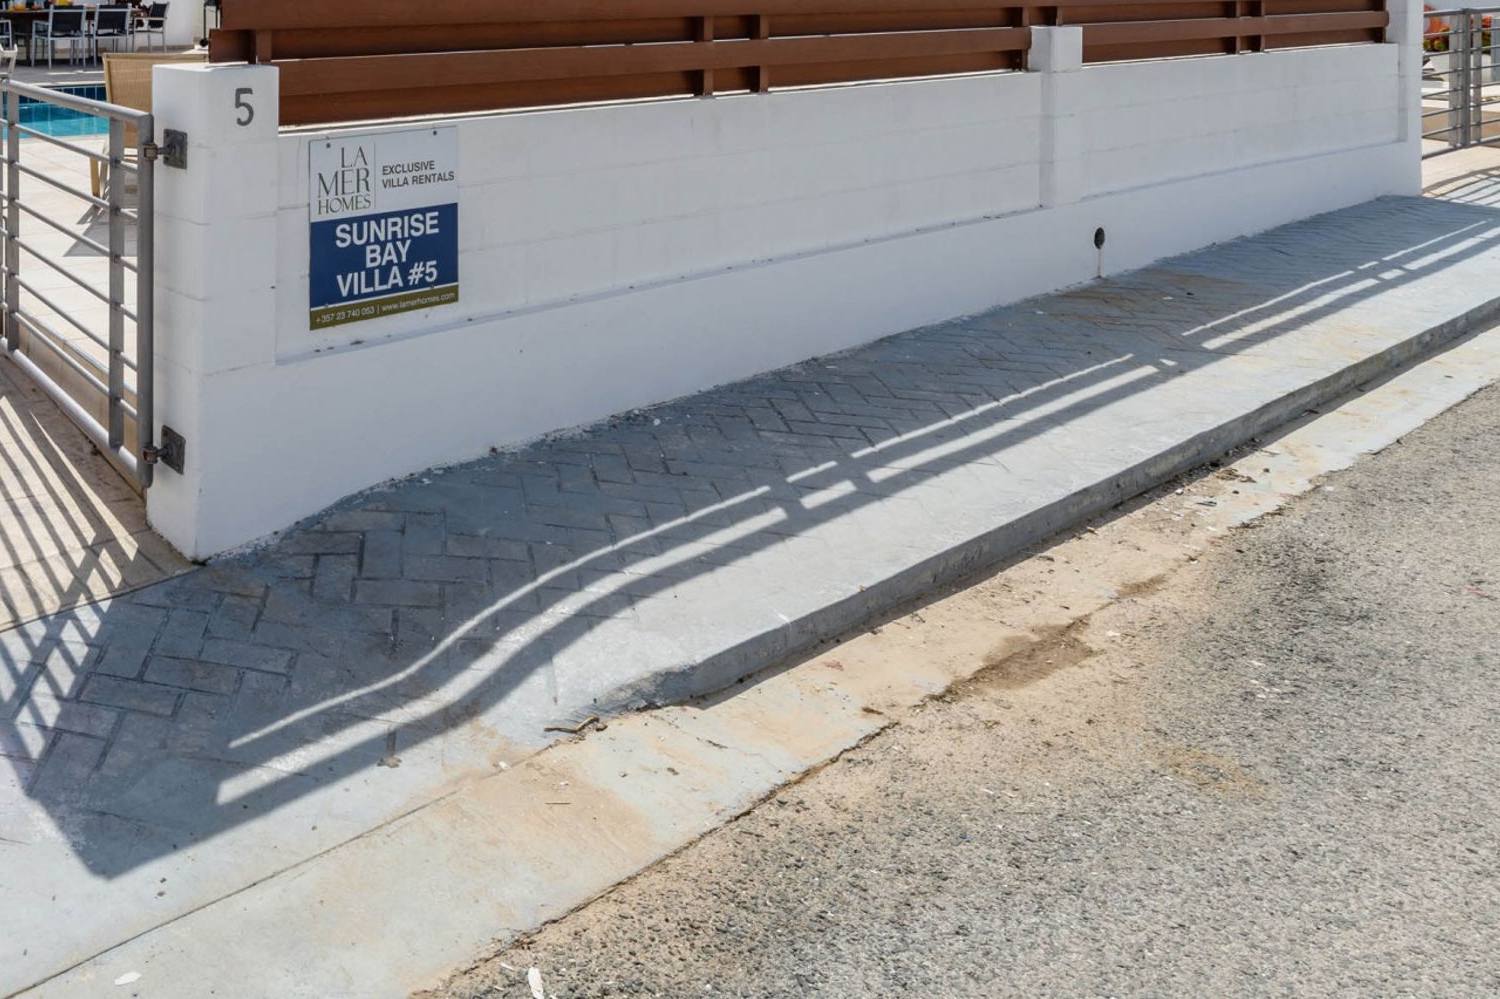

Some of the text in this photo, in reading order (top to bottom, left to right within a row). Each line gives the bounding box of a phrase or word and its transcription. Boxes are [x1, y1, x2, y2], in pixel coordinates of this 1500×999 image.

[234, 87, 254, 127] 5
[341, 146, 368, 168] LA
[382, 160, 435, 176] EXCLUSIVE
[318, 168, 371, 198] MER
[382, 171, 455, 189] VILLA RENTALS
[318, 194, 371, 215] HOMES
[335, 211, 440, 248] SUNRISE
[365, 239, 412, 268] BAY
[336, 260, 438, 298] VILLA #5
